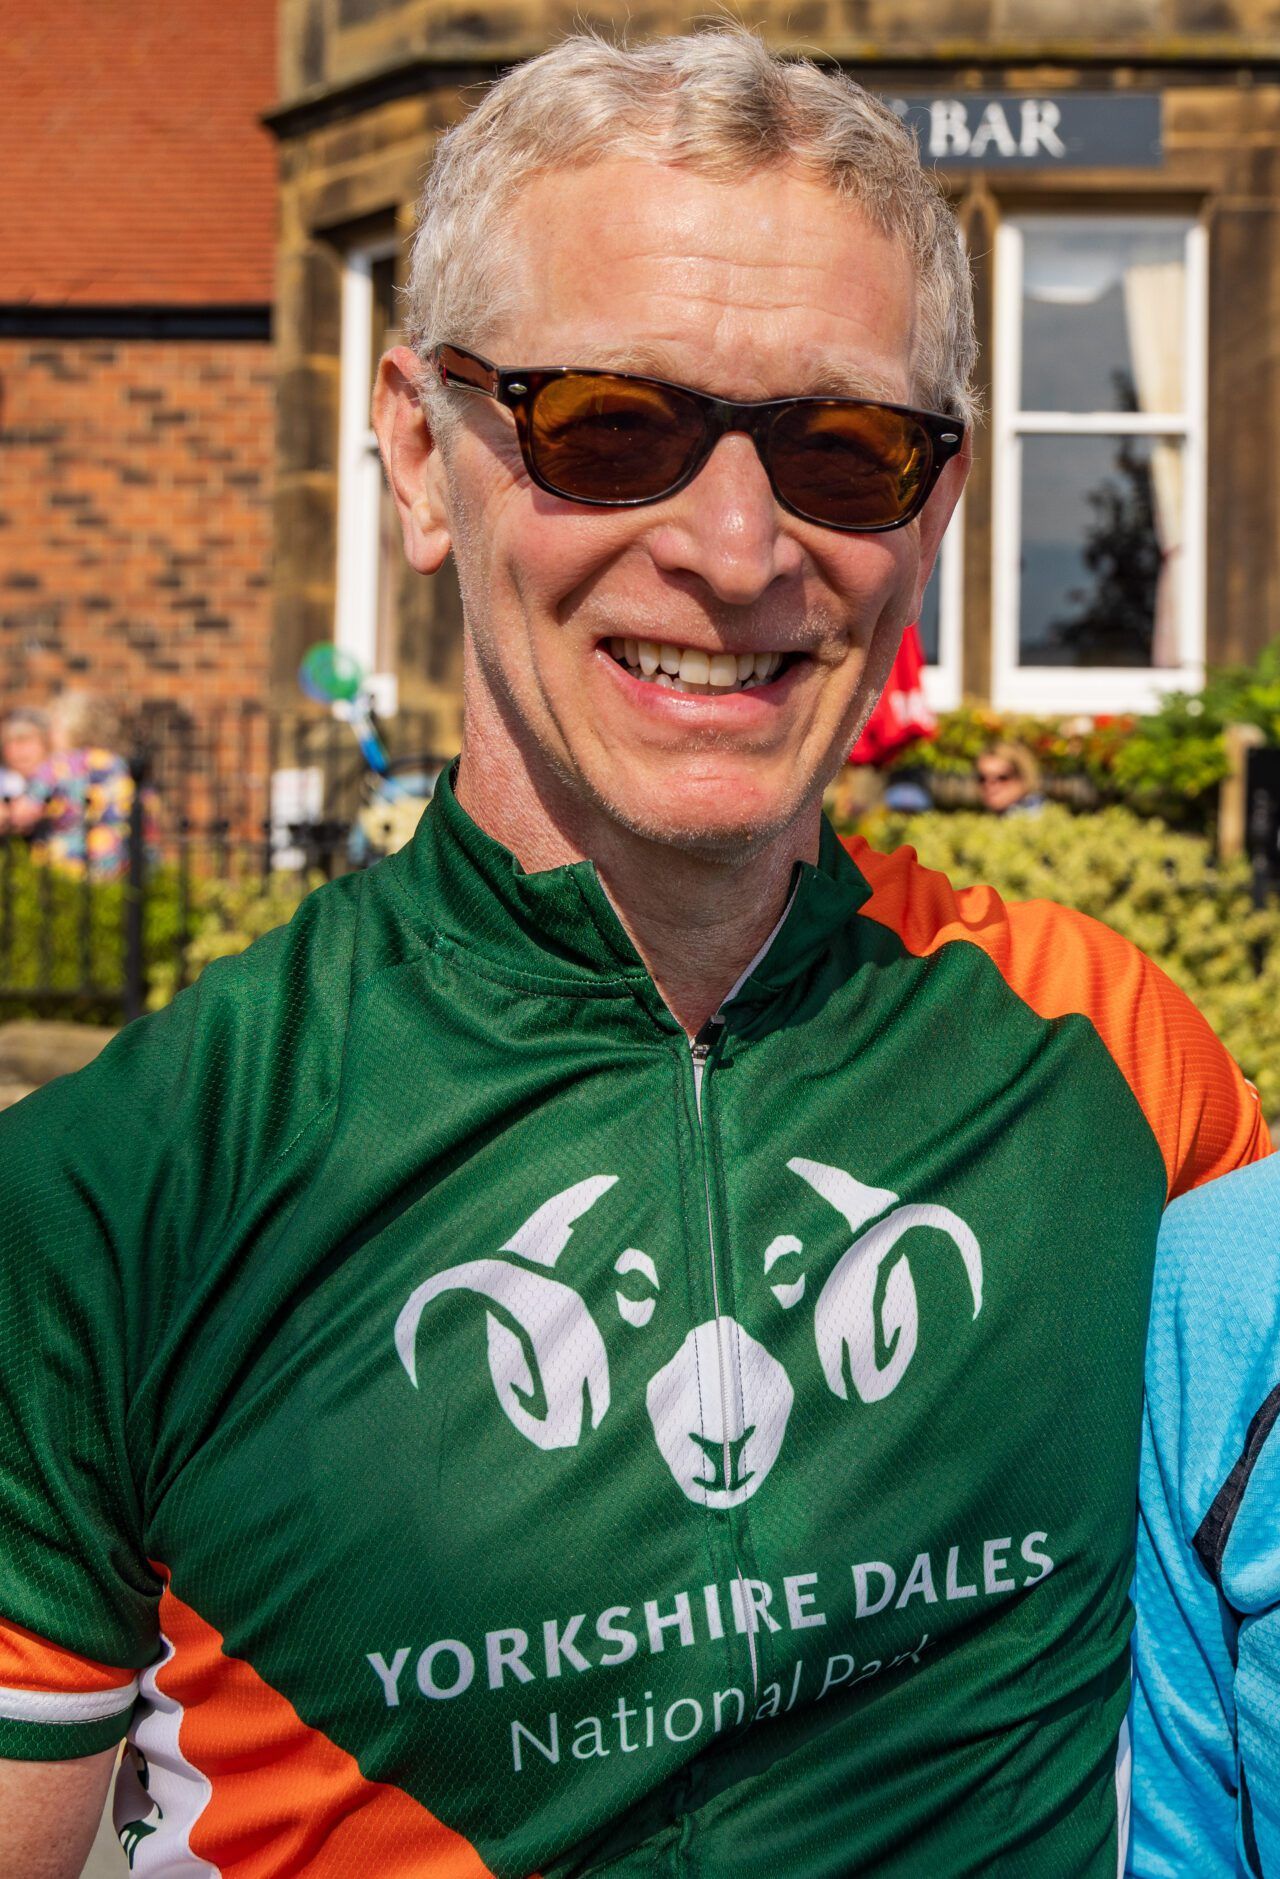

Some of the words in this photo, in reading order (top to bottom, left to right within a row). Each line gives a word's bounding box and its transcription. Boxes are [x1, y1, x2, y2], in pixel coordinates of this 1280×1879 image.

[929, 99, 1066, 158] BAR
[366, 1571, 827, 1708] YORKSHIRE
[851, 1531, 1056, 1619] DALES
[510, 1660, 803, 1772] National
